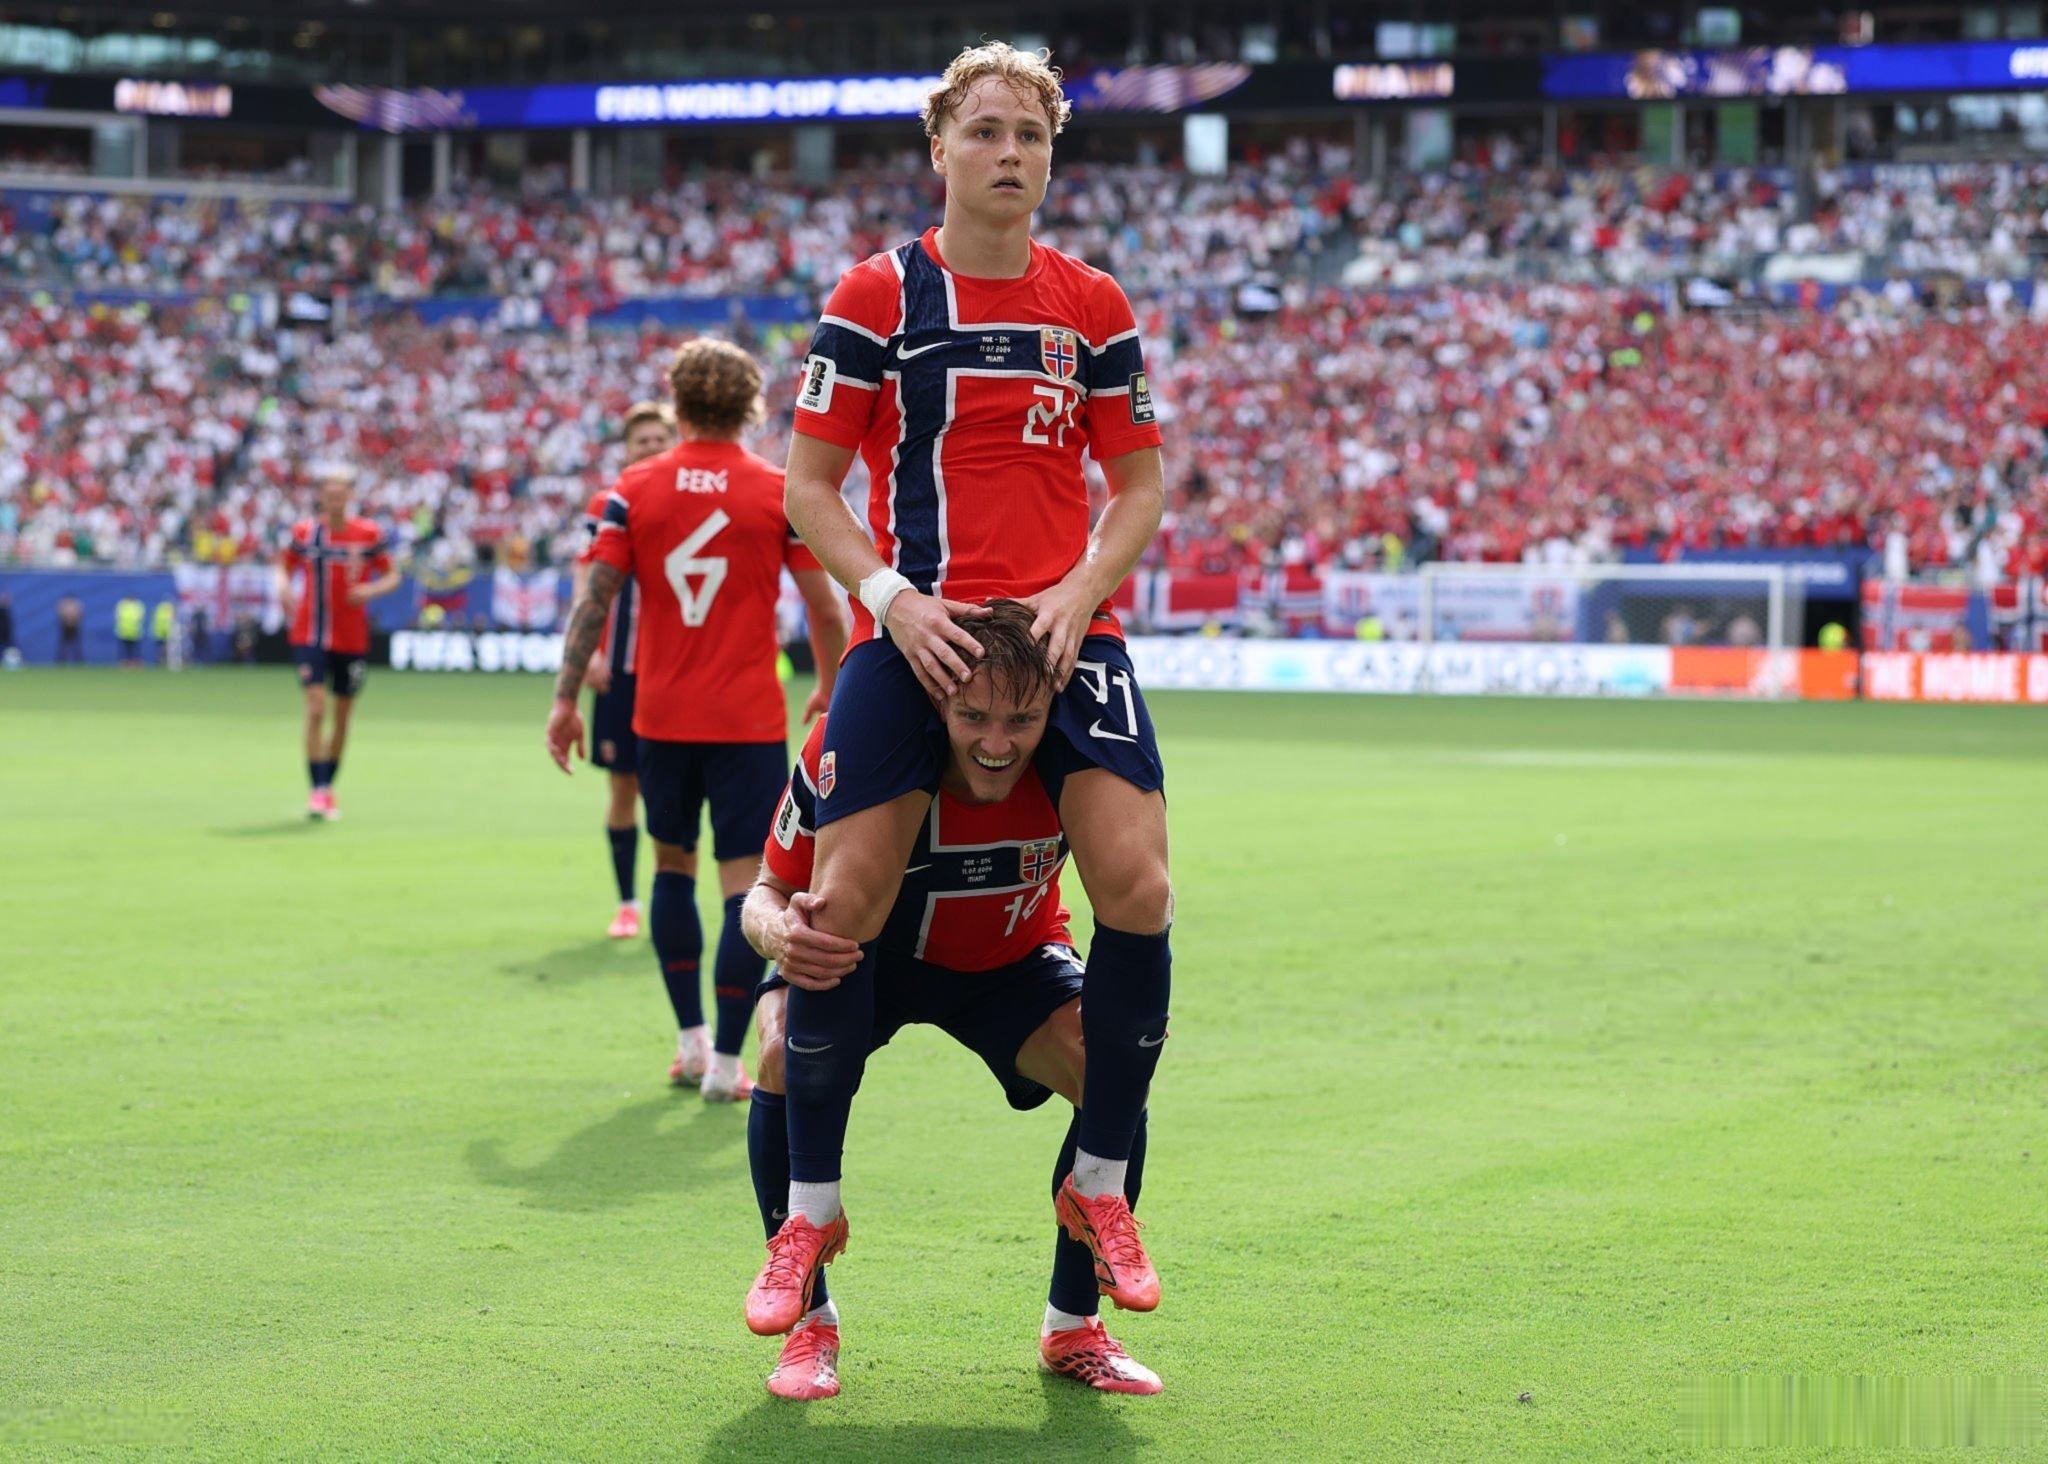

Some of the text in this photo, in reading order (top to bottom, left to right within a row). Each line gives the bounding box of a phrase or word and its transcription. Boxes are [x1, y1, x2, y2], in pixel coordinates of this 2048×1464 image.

[985, 355, 1005, 363] MIAMI
[1022, 384, 1079, 448] 21
[676, 467, 729, 494] BERG
[664, 508, 732, 628] 6
[390, 631, 472, 671] FIFA
